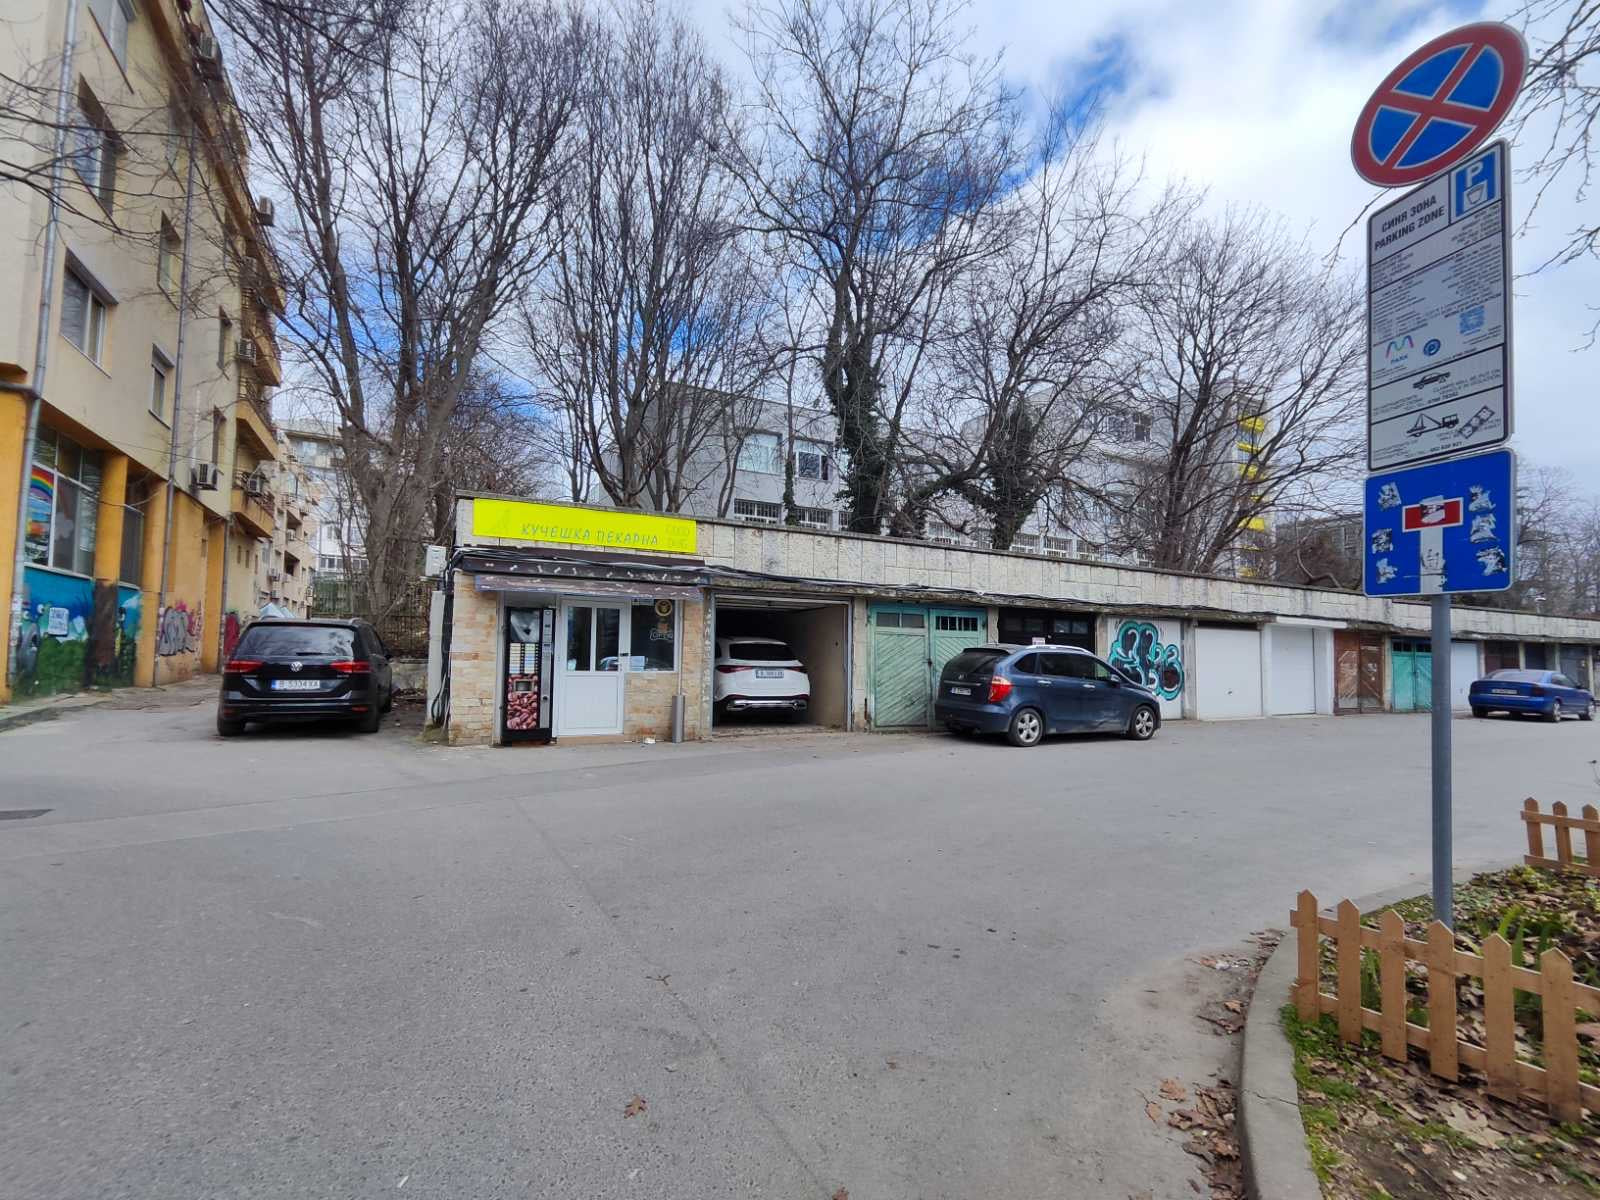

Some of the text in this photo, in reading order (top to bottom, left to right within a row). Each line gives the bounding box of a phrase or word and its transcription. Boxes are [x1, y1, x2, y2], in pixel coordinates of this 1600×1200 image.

[1465, 160, 1484, 188] P
[1374, 221, 1416, 251] PARKING
[1417, 205, 1446, 228] ZONE
[1381, 195, 1437, 233] СИНЯ ЗОНА
[521, 523, 591, 540] КУЧЕШКА
[595, 530, 659, 545] ПЕКАРНА
